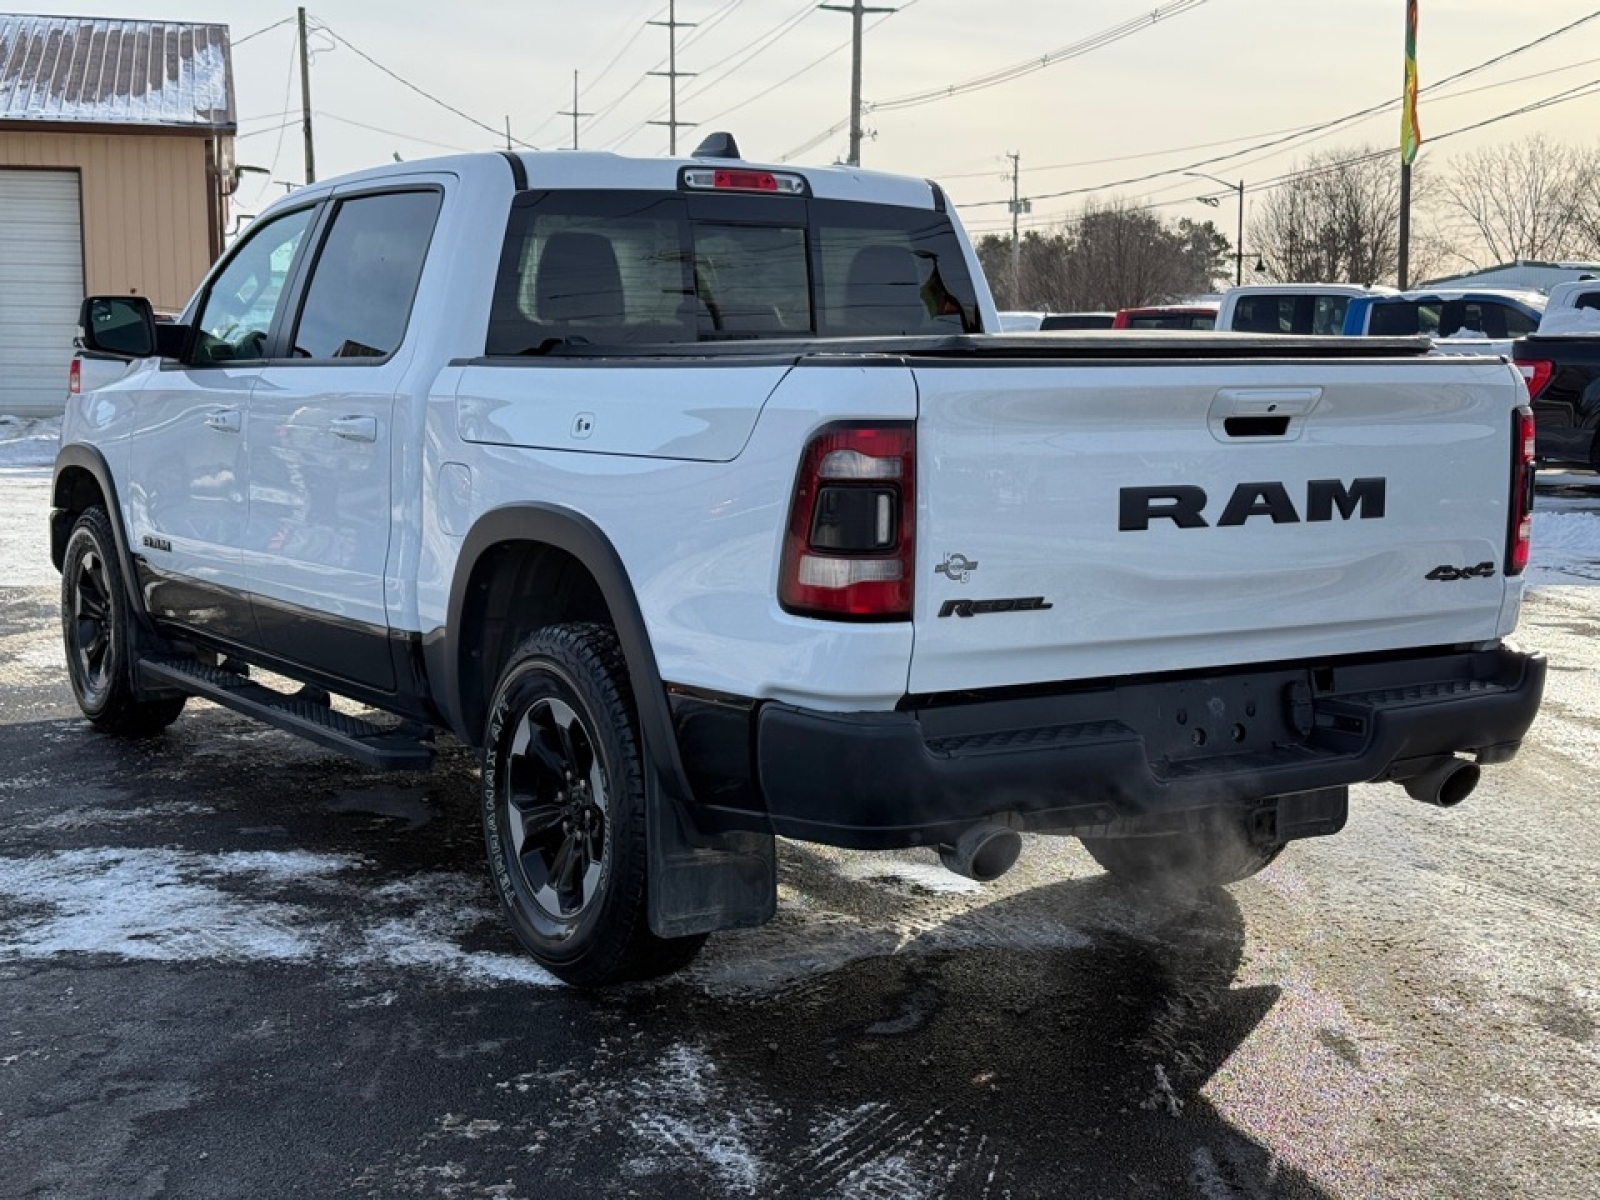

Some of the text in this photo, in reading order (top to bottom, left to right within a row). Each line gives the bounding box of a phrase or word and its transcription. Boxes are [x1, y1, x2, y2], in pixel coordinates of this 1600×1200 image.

[1118, 477, 1387, 532] RAM
[1425, 562, 1495, 581] 4x4
[937, 596, 1053, 618] REBEL
